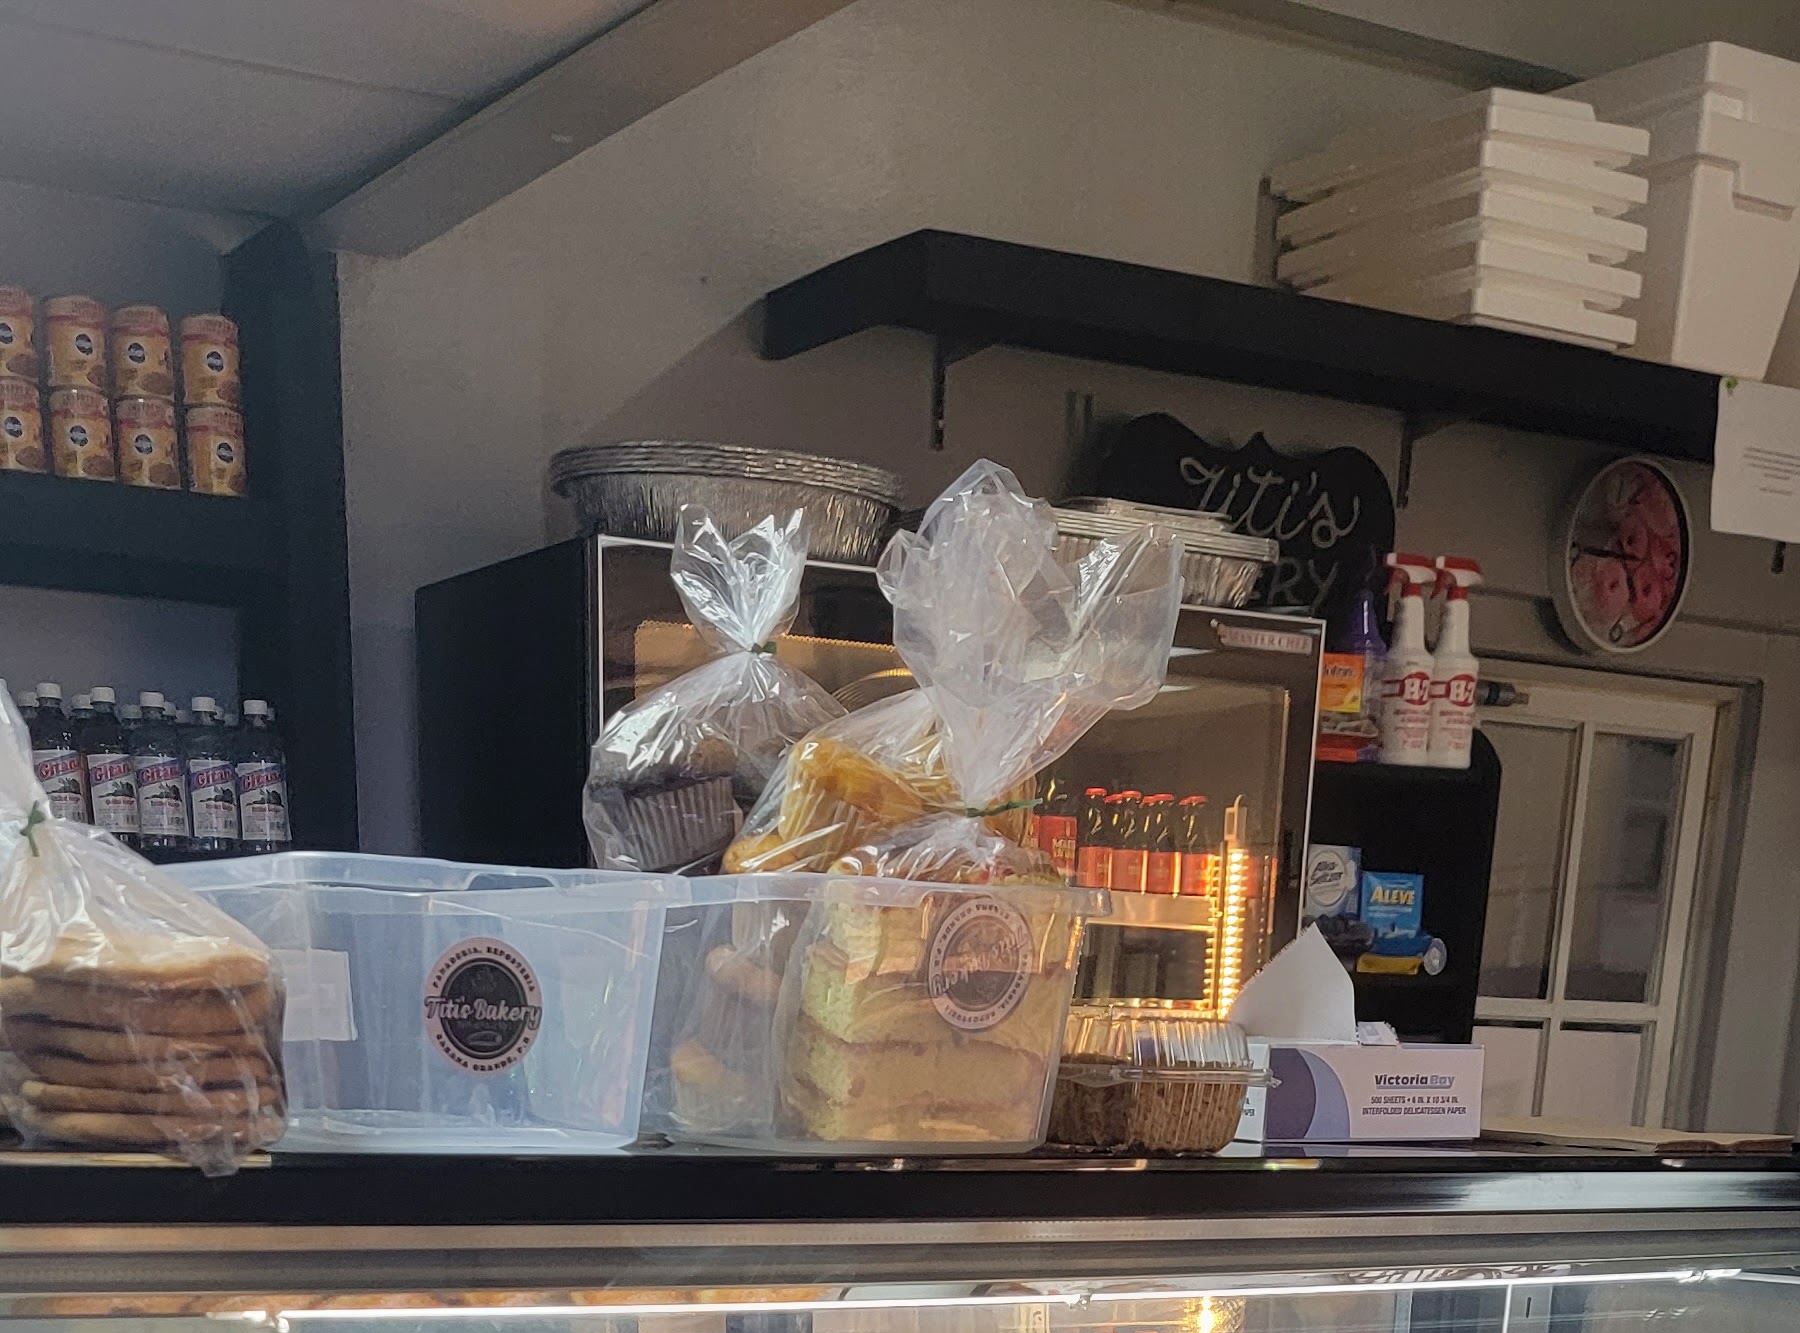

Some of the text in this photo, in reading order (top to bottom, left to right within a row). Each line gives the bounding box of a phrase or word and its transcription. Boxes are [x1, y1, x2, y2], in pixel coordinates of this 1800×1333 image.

[472, 998, 542, 1031] Bakery
[1374, 1074, 1456, 1088] Victoria Bay
[1383, 1096, 1406, 1104] SHEETS
[1447, 1107, 1467, 1115] PAPER
